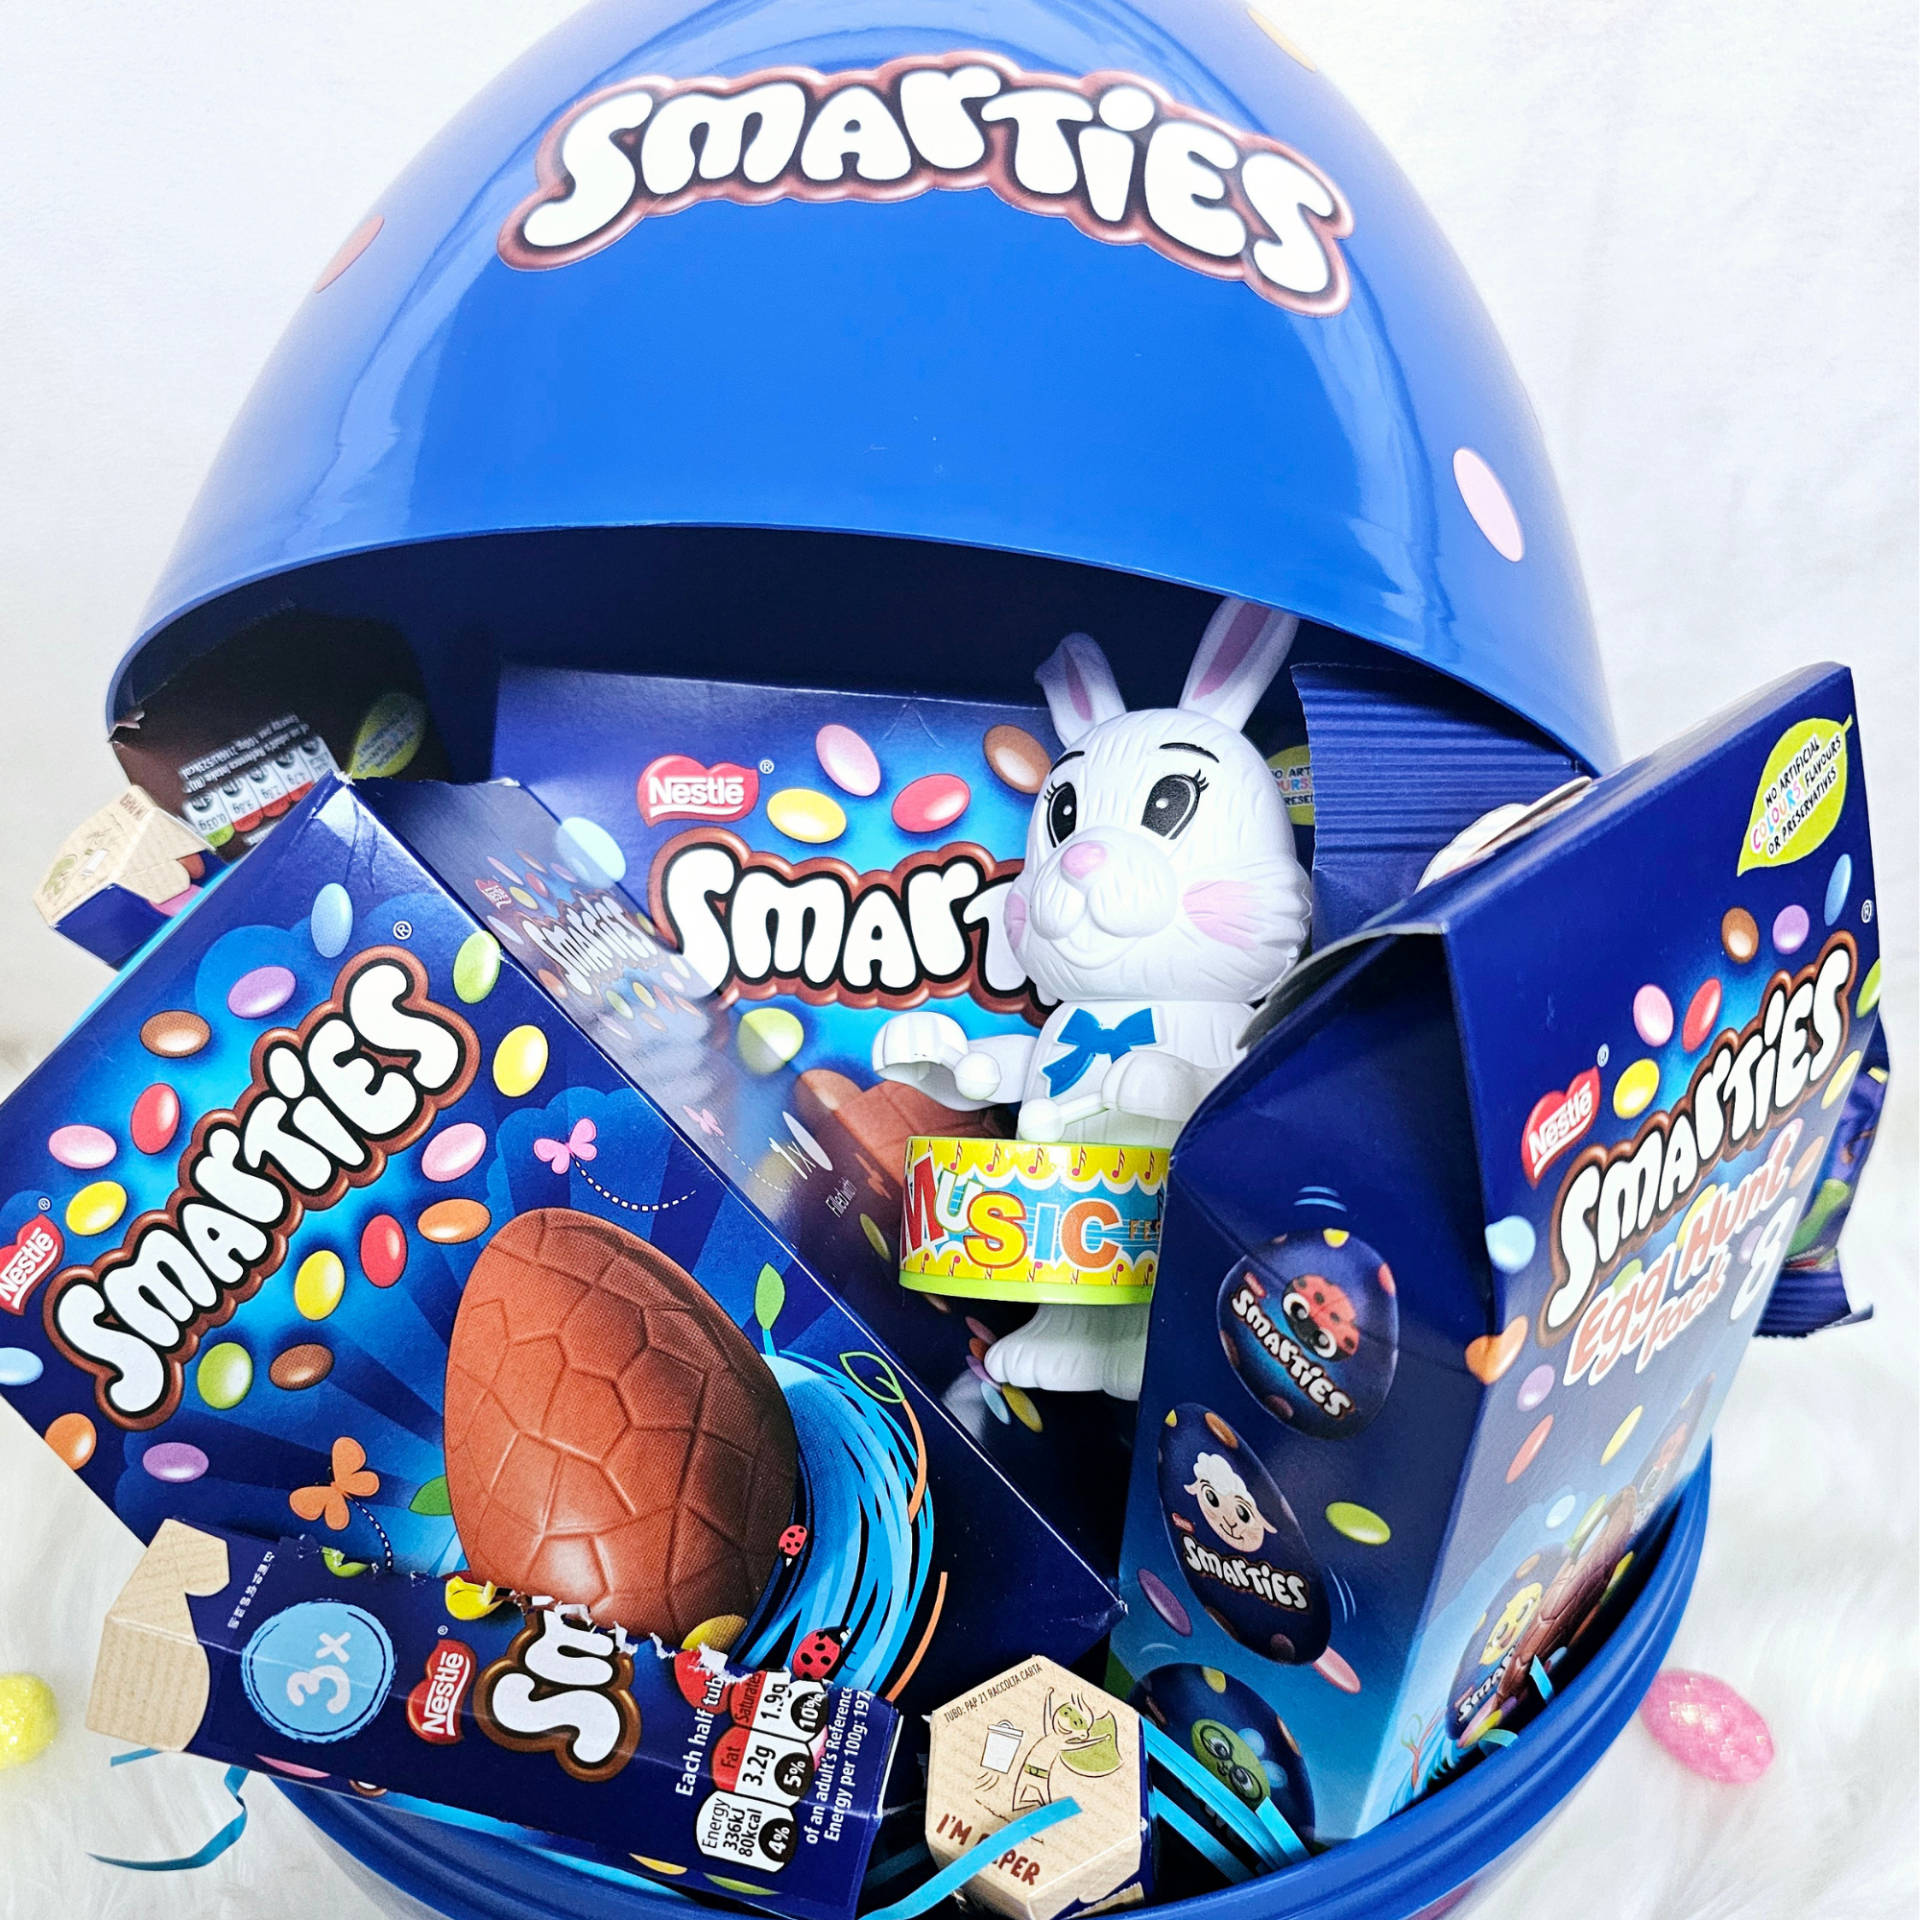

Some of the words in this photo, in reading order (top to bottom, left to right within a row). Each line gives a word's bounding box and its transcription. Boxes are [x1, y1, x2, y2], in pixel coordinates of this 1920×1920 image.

[1766, 788, 1778, 808] NO
[1779, 738, 1820, 792] ARTIFICIAL
[1804, 735, 1841, 787] FLAVOURS
[1768, 836, 1782, 855] OR
[1781, 766, 1837, 842] PRESERVATIVES
[663, 845, 1030, 997] SMART
[54, 961, 461, 1414] SMARTIES
[902, 1155, 1124, 1273] MUSIC
[1566, 1246, 1675, 1383] Egg
[1678, 1130, 1798, 1282] Hunt
[1731, 1197, 1797, 1321] 8
[1230, 1288, 1353, 1420] SMARTIES
[1182, 1534, 1309, 1613] SMARTIES
[734, 1672, 762, 1723] Saturates
[761, 1683, 793, 1721] 1.9g
[799, 1691, 825, 1730] 10%
[943, 1706, 966, 1723] TUBO:
[978, 1691, 989, 1704] 21
[987, 1674, 1021, 1699] RACCOLTA
[1019, 1662, 1043, 1681] CARTA
[688, 1708, 715, 1749] half
[845, 1720, 869, 1762] 100g:
[675, 1749, 703, 1797] Each
[721, 1745, 741, 1770] Fat
[742, 1744, 777, 1787] 3.2g
[783, 1760, 806, 1788] 5%
[815, 1753, 838, 1804] adult's
[840, 1762, 857, 1790] per
[702, 1797, 729, 1850] Energy
[722, 1807, 746, 1851] 336kJ
[738, 1808, 764, 1858] 80kcal
[768, 1825, 790, 1855] 4%
[803, 1824, 819, 1845] of
[810, 1805, 826, 1825] an
[824, 1790, 854, 1843] Energy
[936, 1813, 972, 1846] I'M
